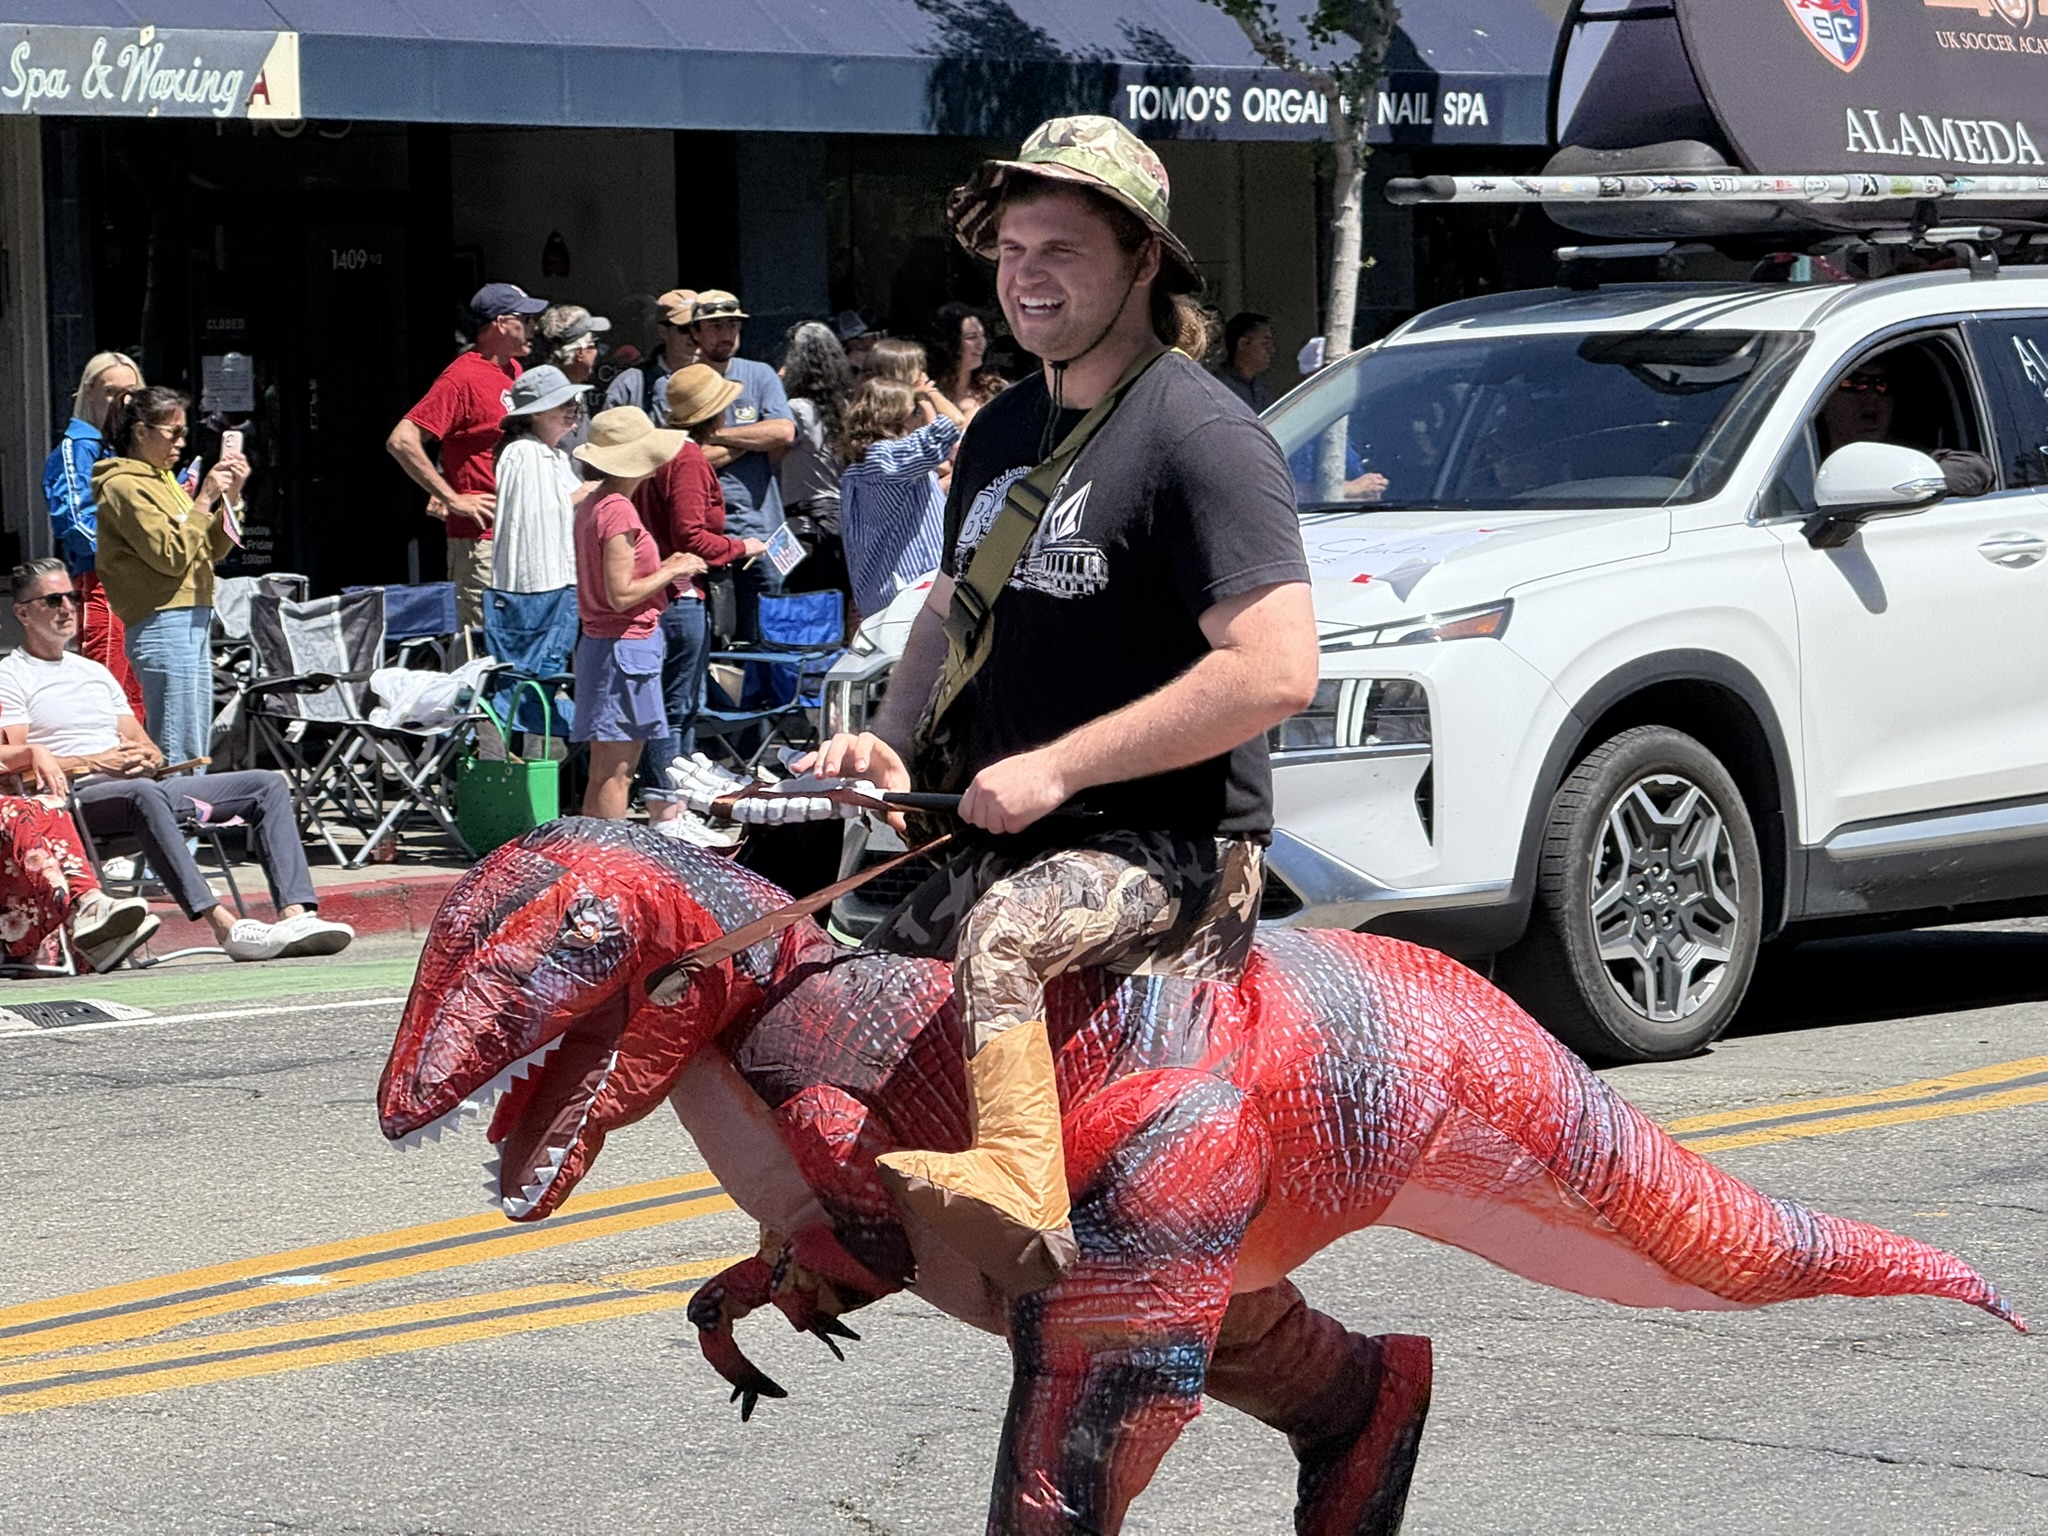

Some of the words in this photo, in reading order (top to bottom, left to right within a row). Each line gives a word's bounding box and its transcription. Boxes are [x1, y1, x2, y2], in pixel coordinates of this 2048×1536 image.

[1813, 15, 1858, 43] SC
[1935, 31, 1960, 48] UK
[1960, 32, 2018, 52] SOCCER
[2, 41, 70, 110] Spa
[82, 37, 115, 99] &
[117, 43, 244, 117] Waxing
[1126, 84, 1231, 122] TOMO'S
[1377, 92, 1433, 125] NAIL
[1443, 92, 1489, 126] SPA
[1846, 107, 2046, 165] ALAMEDA
[330, 249, 367, 270] 1409
[206, 318, 245, 330] CLOSED
[985, 466, 1032, 491] Volcom
[246, 539, 274, 551] Friday
